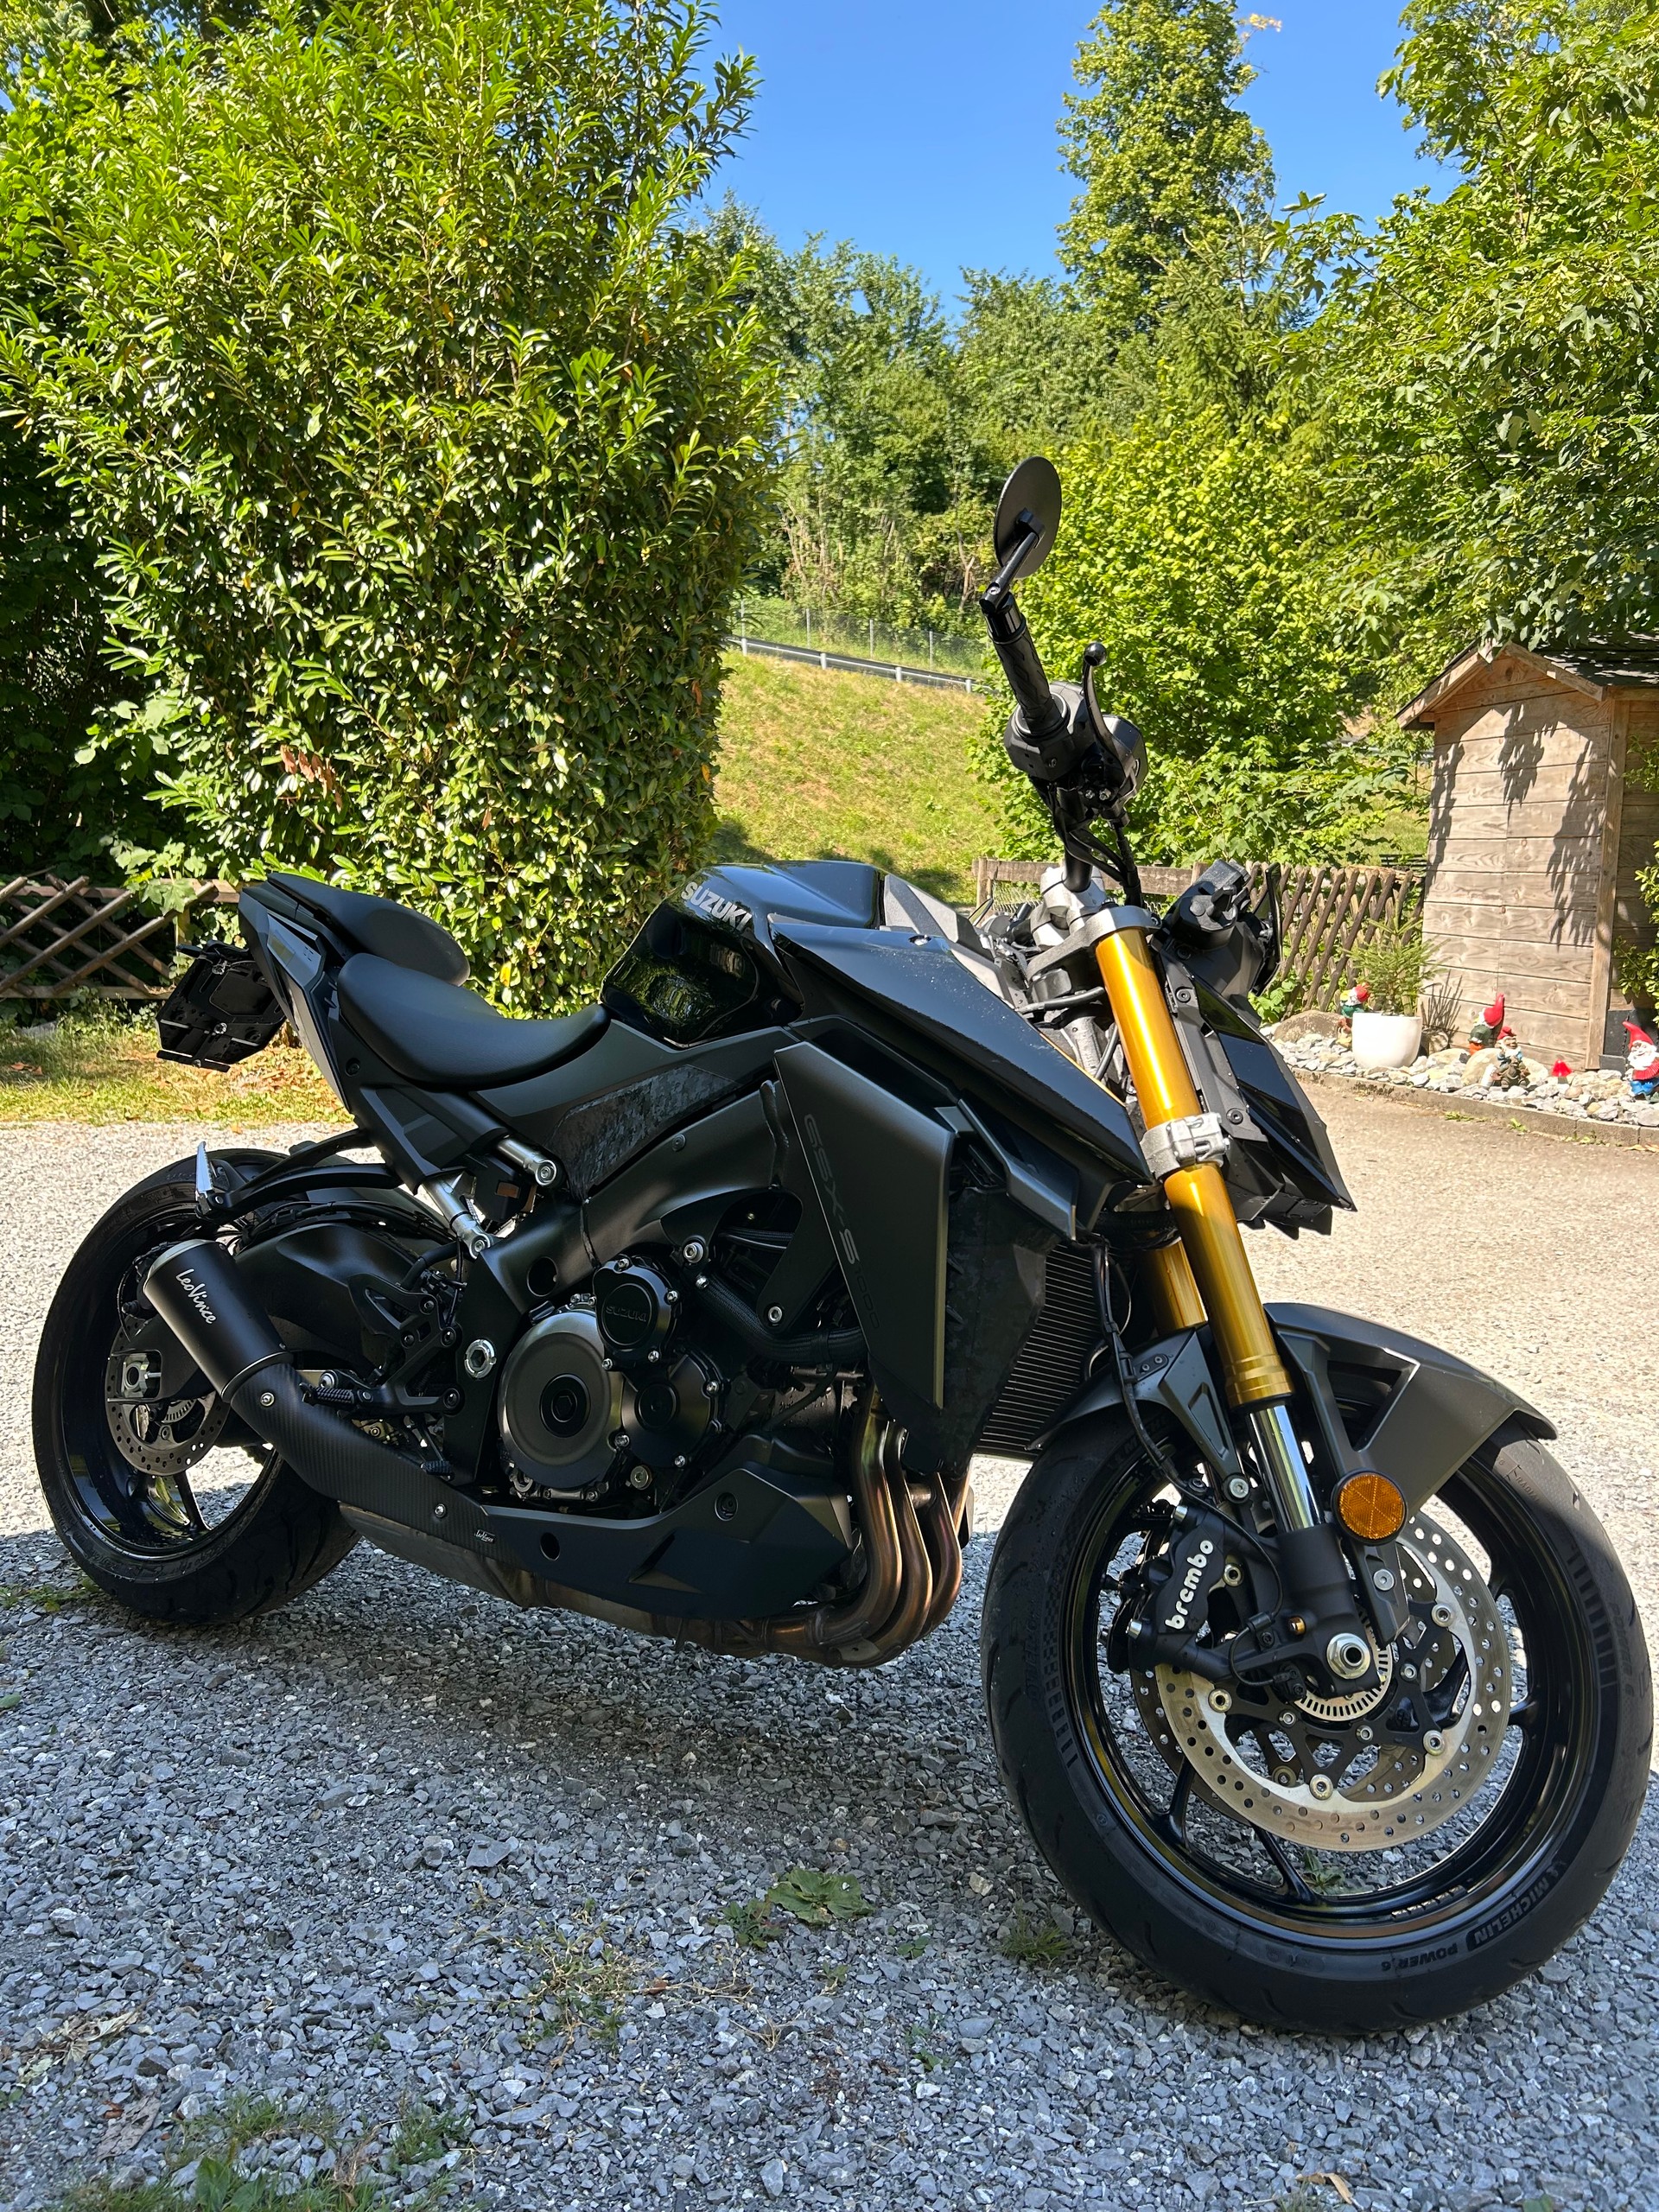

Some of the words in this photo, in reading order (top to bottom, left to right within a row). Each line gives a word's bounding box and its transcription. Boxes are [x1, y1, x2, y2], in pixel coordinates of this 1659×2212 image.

[681, 882, 752, 932] SUZUKI
[175, 1268, 217, 1324] LeoVince
[605, 1306, 647, 1322] SUZUKI
[1165, 1540, 1214, 1630] brembo
[1473, 1876, 1550, 1944] MICHELIN
[1381, 1960, 1392, 1971] 6
[1397, 1943, 1459, 1969] POWER
